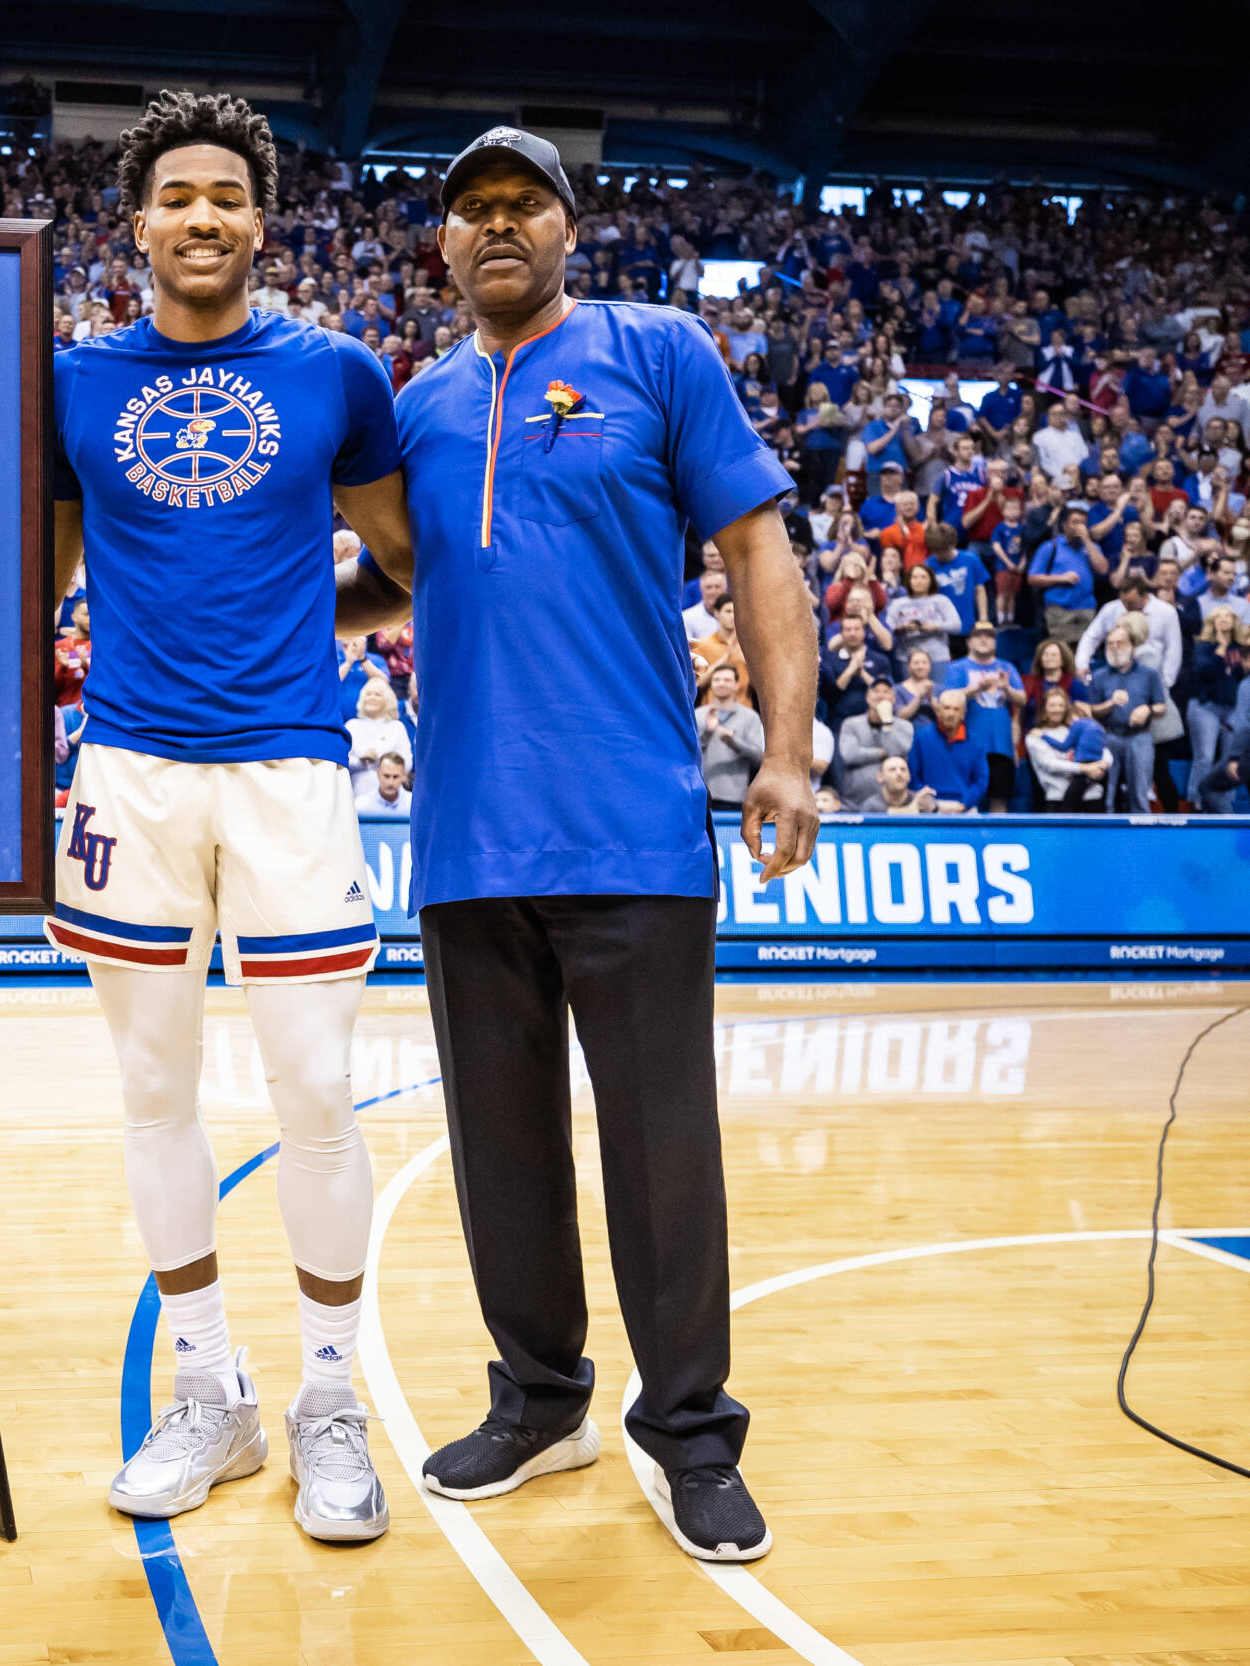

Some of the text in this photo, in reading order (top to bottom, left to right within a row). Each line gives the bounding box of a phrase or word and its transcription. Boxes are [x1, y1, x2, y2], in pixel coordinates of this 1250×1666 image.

[114, 367, 282, 463] KANSAS JAYHAWKS
[125, 460, 271, 508] BASKETBALL
[67, 802, 117, 891] KU
[344, 893, 365, 903] adidas
[717, 842, 1035, 925] ENIORS
[757, 946, 877, 963] ROCKET Mortgage
[1110, 945, 1225, 962] ROCKET Mortgage
